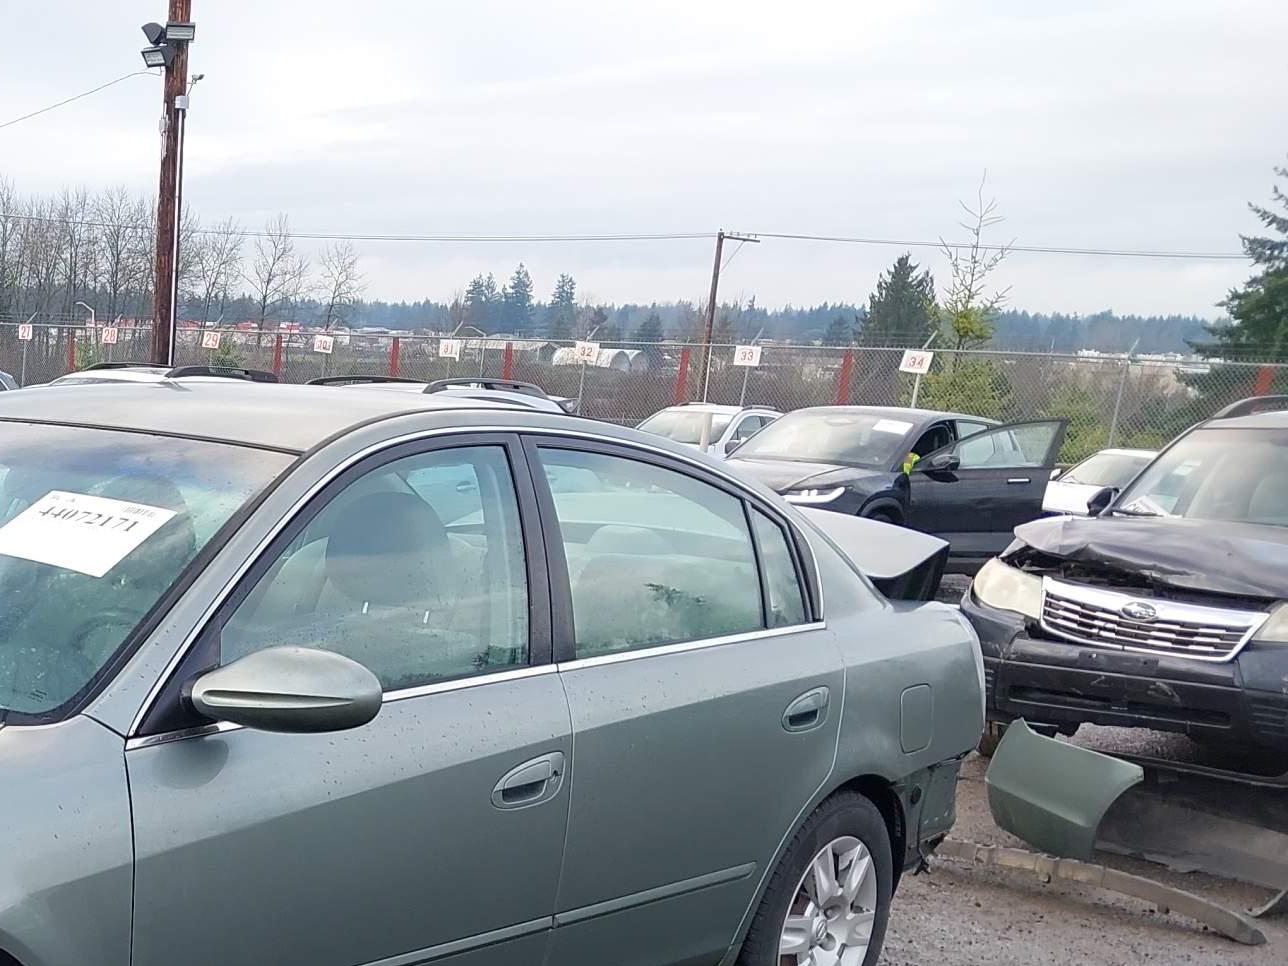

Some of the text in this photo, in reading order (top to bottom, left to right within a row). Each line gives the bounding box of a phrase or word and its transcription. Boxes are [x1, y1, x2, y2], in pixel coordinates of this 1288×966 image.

[21, 325, 30, 337] 27
[104, 328, 116, 341] 28
[204, 333, 218, 347] 29
[580, 348, 593, 357] 32
[740, 352, 754, 361] 33
[908, 357, 924, 368] 34
[39, 506, 139, 532] 44072171
